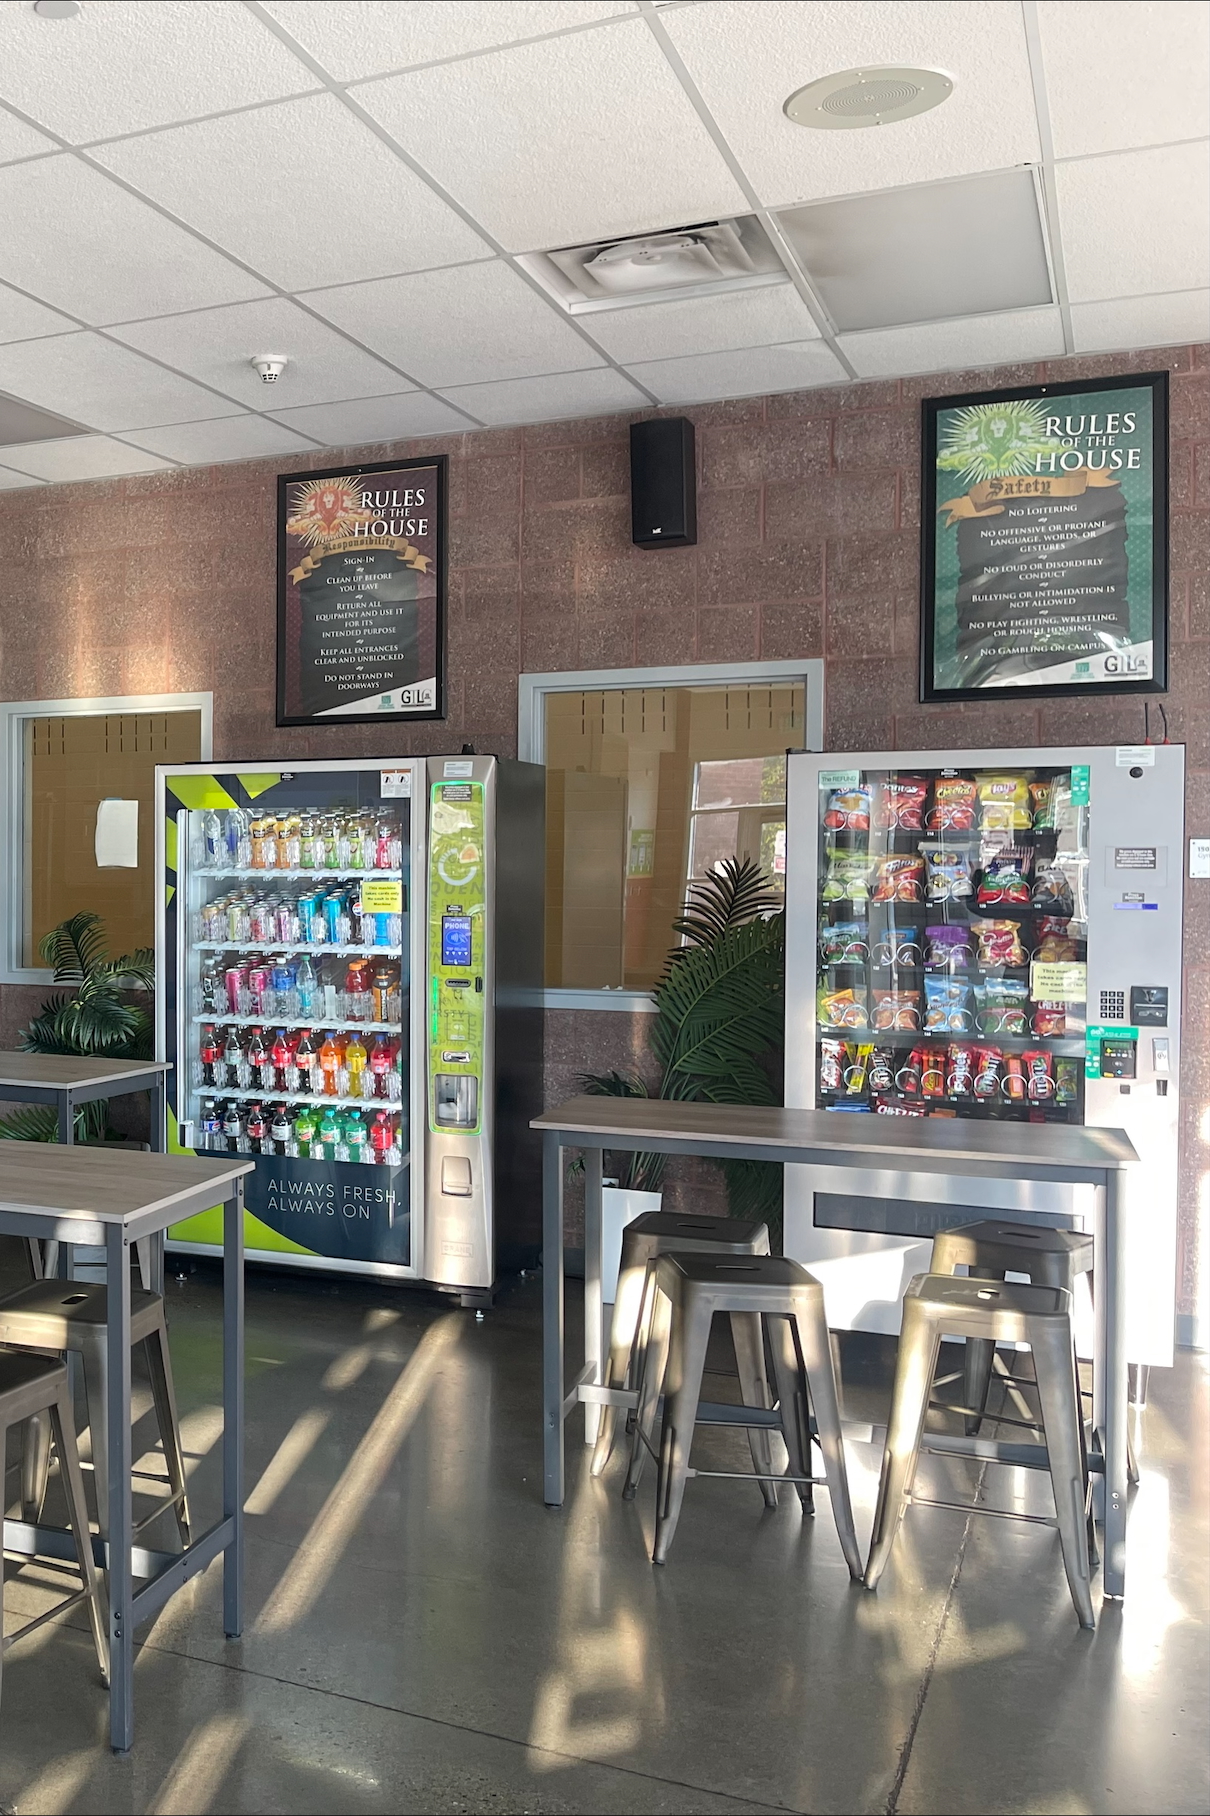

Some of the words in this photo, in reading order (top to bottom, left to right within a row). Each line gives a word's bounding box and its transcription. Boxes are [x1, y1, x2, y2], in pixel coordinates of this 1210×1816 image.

[1045, 412, 1136, 437] RULES
[1061, 436, 1081, 448] OF
[1084, 435, 1116, 447] THE
[1035, 448, 1140, 472] HOUSE
[988, 477, 1051, 497] Safety
[361, 488, 426, 509] RULES
[372, 508, 386, 518] OF
[389, 508, 410, 517] THE
[1008, 508, 1025, 518] NO
[1026, 504, 1078, 516] LOITERING
[354, 518, 428, 538] HOUSE
[980, 529, 996, 539] NO
[997, 526, 1047, 537] OFFENSIVE
[1048, 524, 1063, 532] OR
[1064, 520, 1107, 531] PROFANE
[323, 536, 396, 554] Responsibility
[990, 536, 1040, 547] LANGUAGE,
[1042, 533, 1080, 543] WORDS,
[1082, 530, 1097, 538] OR
[1020, 542, 1066, 553] GESTURES
[344, 556, 375, 566] SIGN-IN
[984, 565, 1000, 575] NO
[1001, 564, 1028, 573] LOUD
[1029, 562, 1044, 572] OR
[1046, 558, 1104, 570] DISORDERLY
[326, 576, 351, 585] CLEAN
[365, 572, 392, 580] BEFORE
[1018, 570, 1066, 581] CONDUCT
[340, 584, 356, 592] YOU
[358, 583, 378, 591] LEAVE
[972, 592, 1017, 602] BULLYING
[1018, 591, 1034, 599] OR
[1035, 586, 1104, 598] INTIMIDATION
[1106, 585, 1116, 594] IS
[336, 602, 367, 610] RETURN
[1009, 600, 1030, 609] NOT
[1032, 597, 1076, 608] ALLOWED
[315, 611, 359, 622] EQUIPMENT
[360, 609, 378, 617] AND
[380, 608, 393, 616] USE
[344, 620, 360, 628] FOR
[969, 621, 986, 630] NO
[986, 619, 1009, 629] PLAY
[1010, 616, 1060, 628] FIGHTING,
[322, 629, 362, 638] INTENDED
[364, 627, 396, 636] PURPOSE
[994, 629, 1008, 638] OR
[1009, 626, 1046, 637] ROUGH
[1047, 624, 1092, 634] HOUSING
[320, 648, 338, 656] KEEP
[354, 645, 399, 654] ENTRANCES
[980, 648, 996, 657] NO
[998, 645, 1048, 656] GAMBLING
[1050, 644, 1066, 652] ON
[1068, 642, 1106, 652] CAMPUS
[314, 658, 338, 666] CLEAR
[358, 654, 404, 663] UNBLOCKED
[324, 674, 338, 683] DO
[357, 672, 382, 680] STAND
[338, 682, 380, 690] DOORWAYS
[268, 1178, 334, 1198] ALWAYS
[268, 1196, 334, 1216] ALWAYS
[342, 1203, 370, 1220] ON
